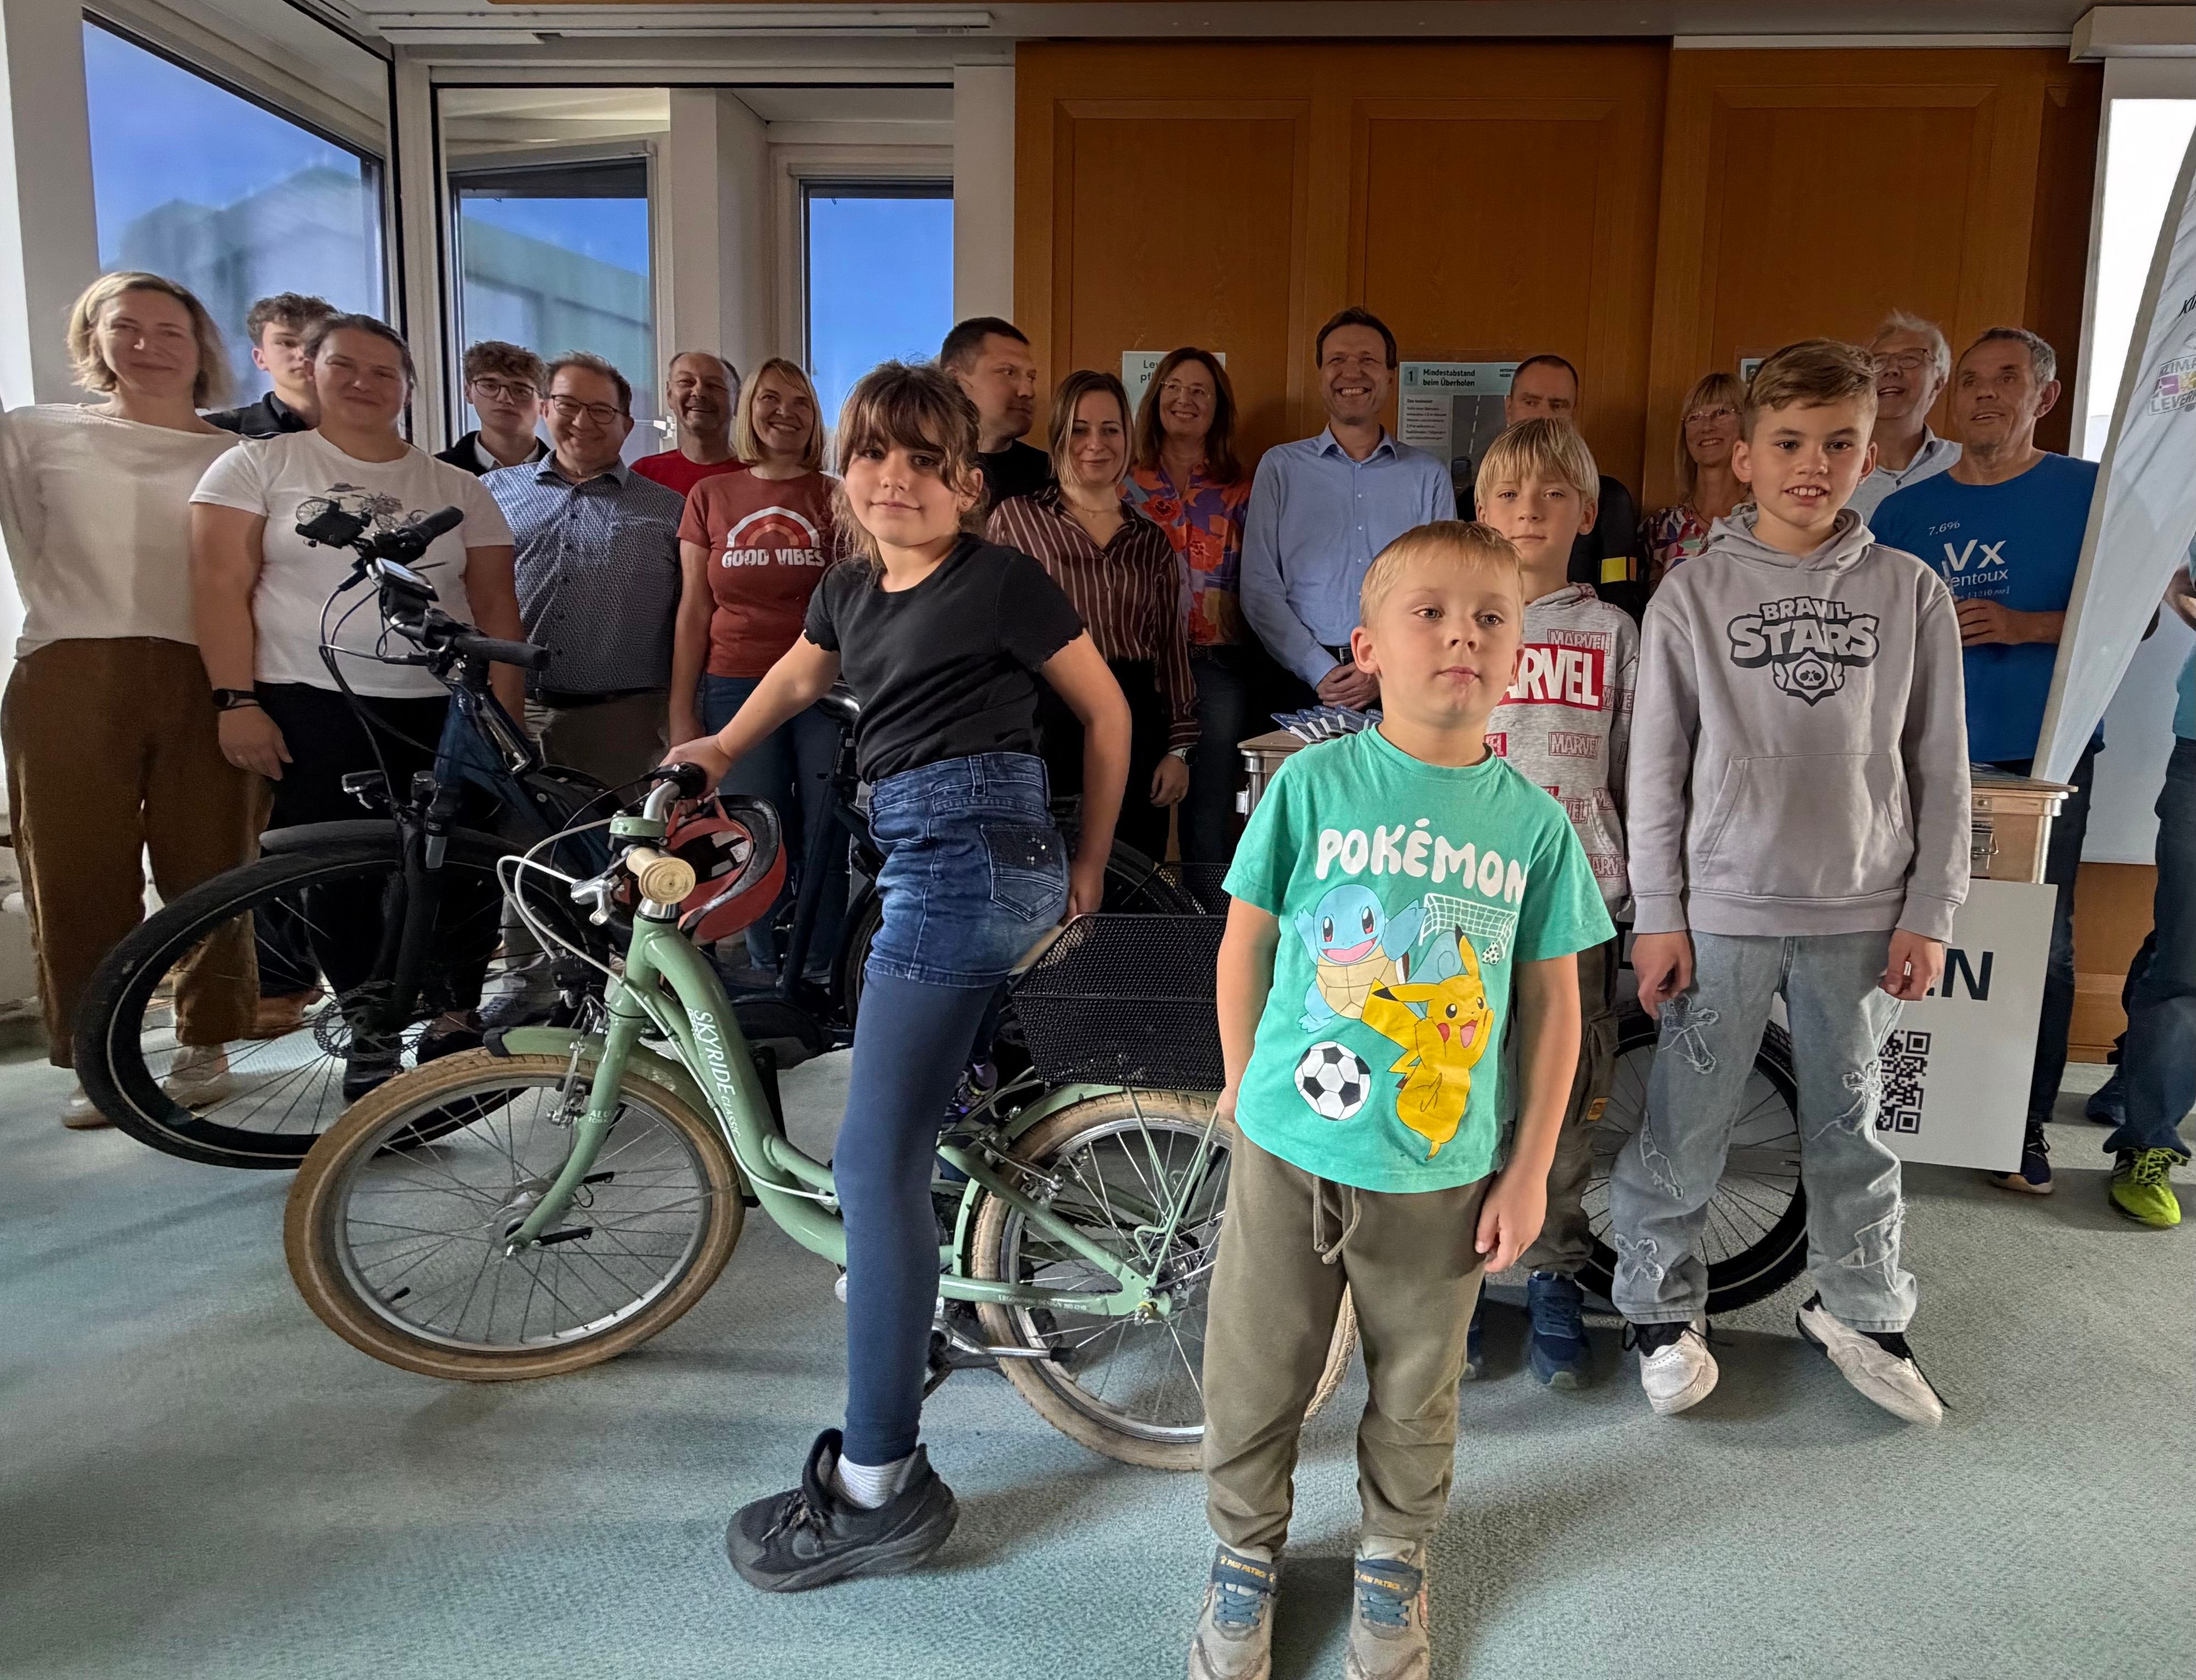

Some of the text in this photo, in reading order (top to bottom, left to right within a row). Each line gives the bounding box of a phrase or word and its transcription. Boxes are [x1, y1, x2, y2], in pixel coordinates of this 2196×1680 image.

[1409, 371, 1413, 382] 1
[1441, 377, 1475, 387] Überholen
[721, 548, 826, 568] GOOD VIBES
[1950, 569, 2009, 587] entoux
[1760, 596, 1852, 621] BRAWL
[1728, 614, 1879, 667] STARS
[1316, 817, 1529, 904] POKÉMON
[693, 1010, 736, 1096] SKYRIDE
[721, 1095, 741, 1138] CLASSIC
